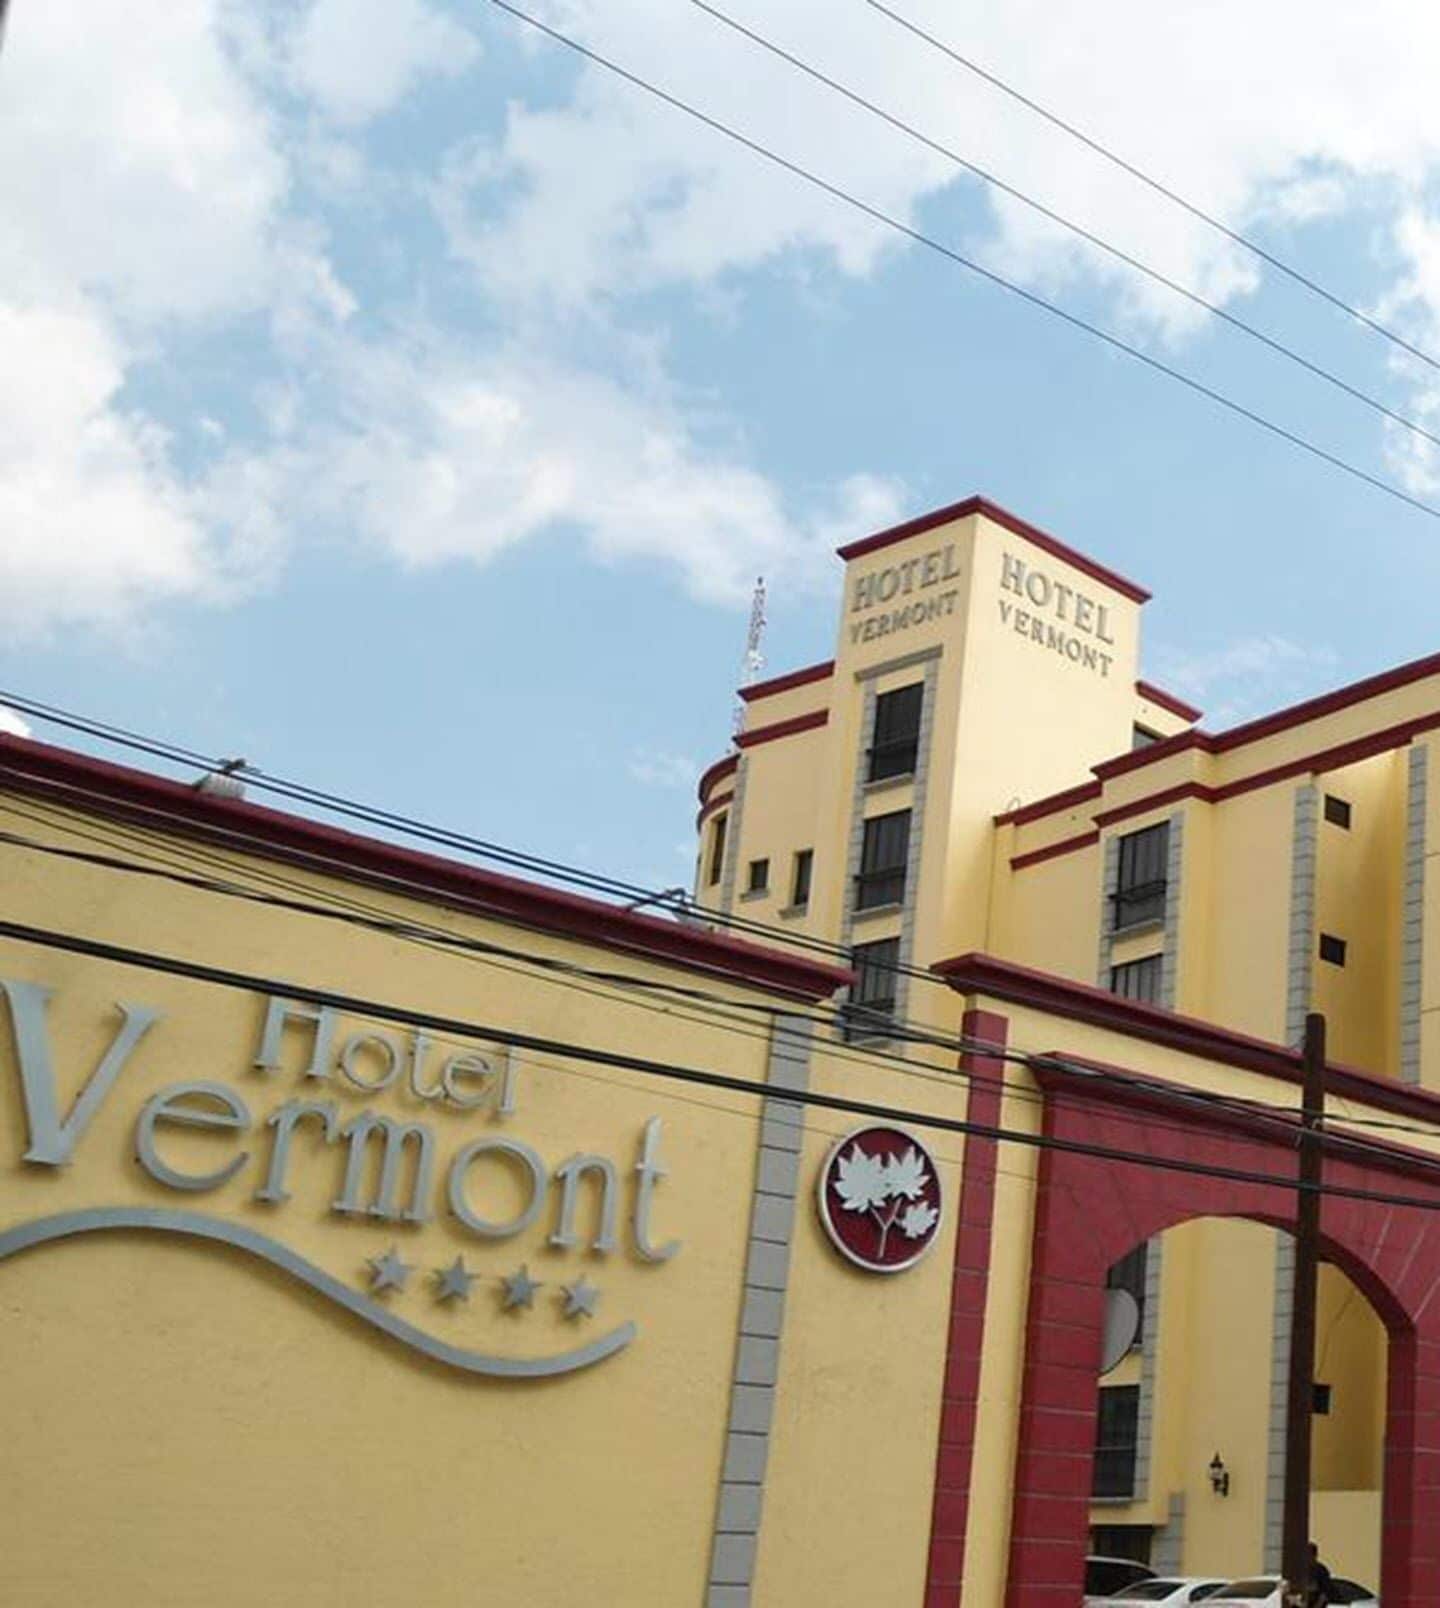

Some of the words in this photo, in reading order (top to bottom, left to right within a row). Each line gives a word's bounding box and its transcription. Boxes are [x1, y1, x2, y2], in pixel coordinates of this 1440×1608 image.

[851, 590, 957, 643] VERMONT
[852, 544, 960, 612] HOTEL
[1000, 552, 1114, 645] HOTEL
[999, 601, 1112, 677] VERMONT
[253, 988, 516, 1114] Hotel
[2, 979, 680, 1262] Vermont
